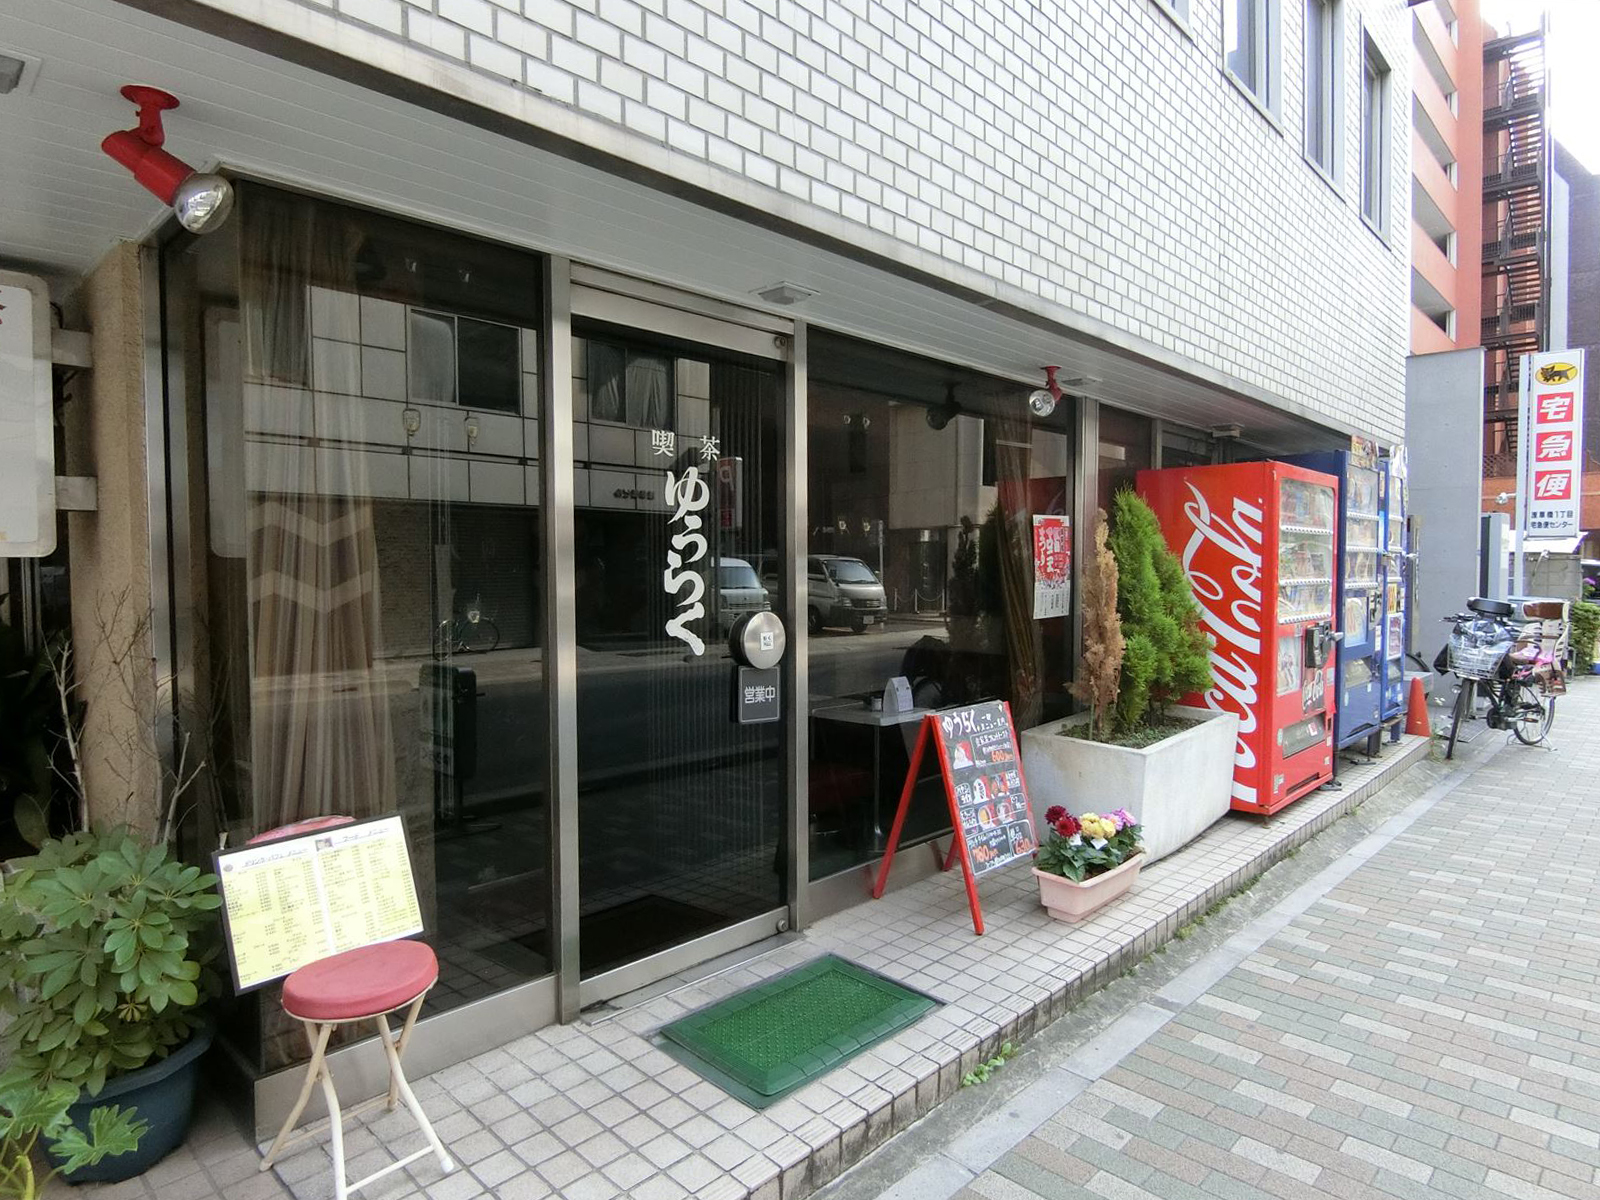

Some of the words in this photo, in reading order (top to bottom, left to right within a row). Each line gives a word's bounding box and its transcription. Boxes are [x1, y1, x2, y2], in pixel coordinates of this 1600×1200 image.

[1537, 396, 1570, 497] 宅急便
[1530, 521, 1573, 529] 宅急便センター
[664, 466, 710, 657] ゆうらく
[1181, 478, 1264, 804] ca-Cola
[744, 686, 776, 704] 営業中
[942, 709, 977, 739] ゆうらく
